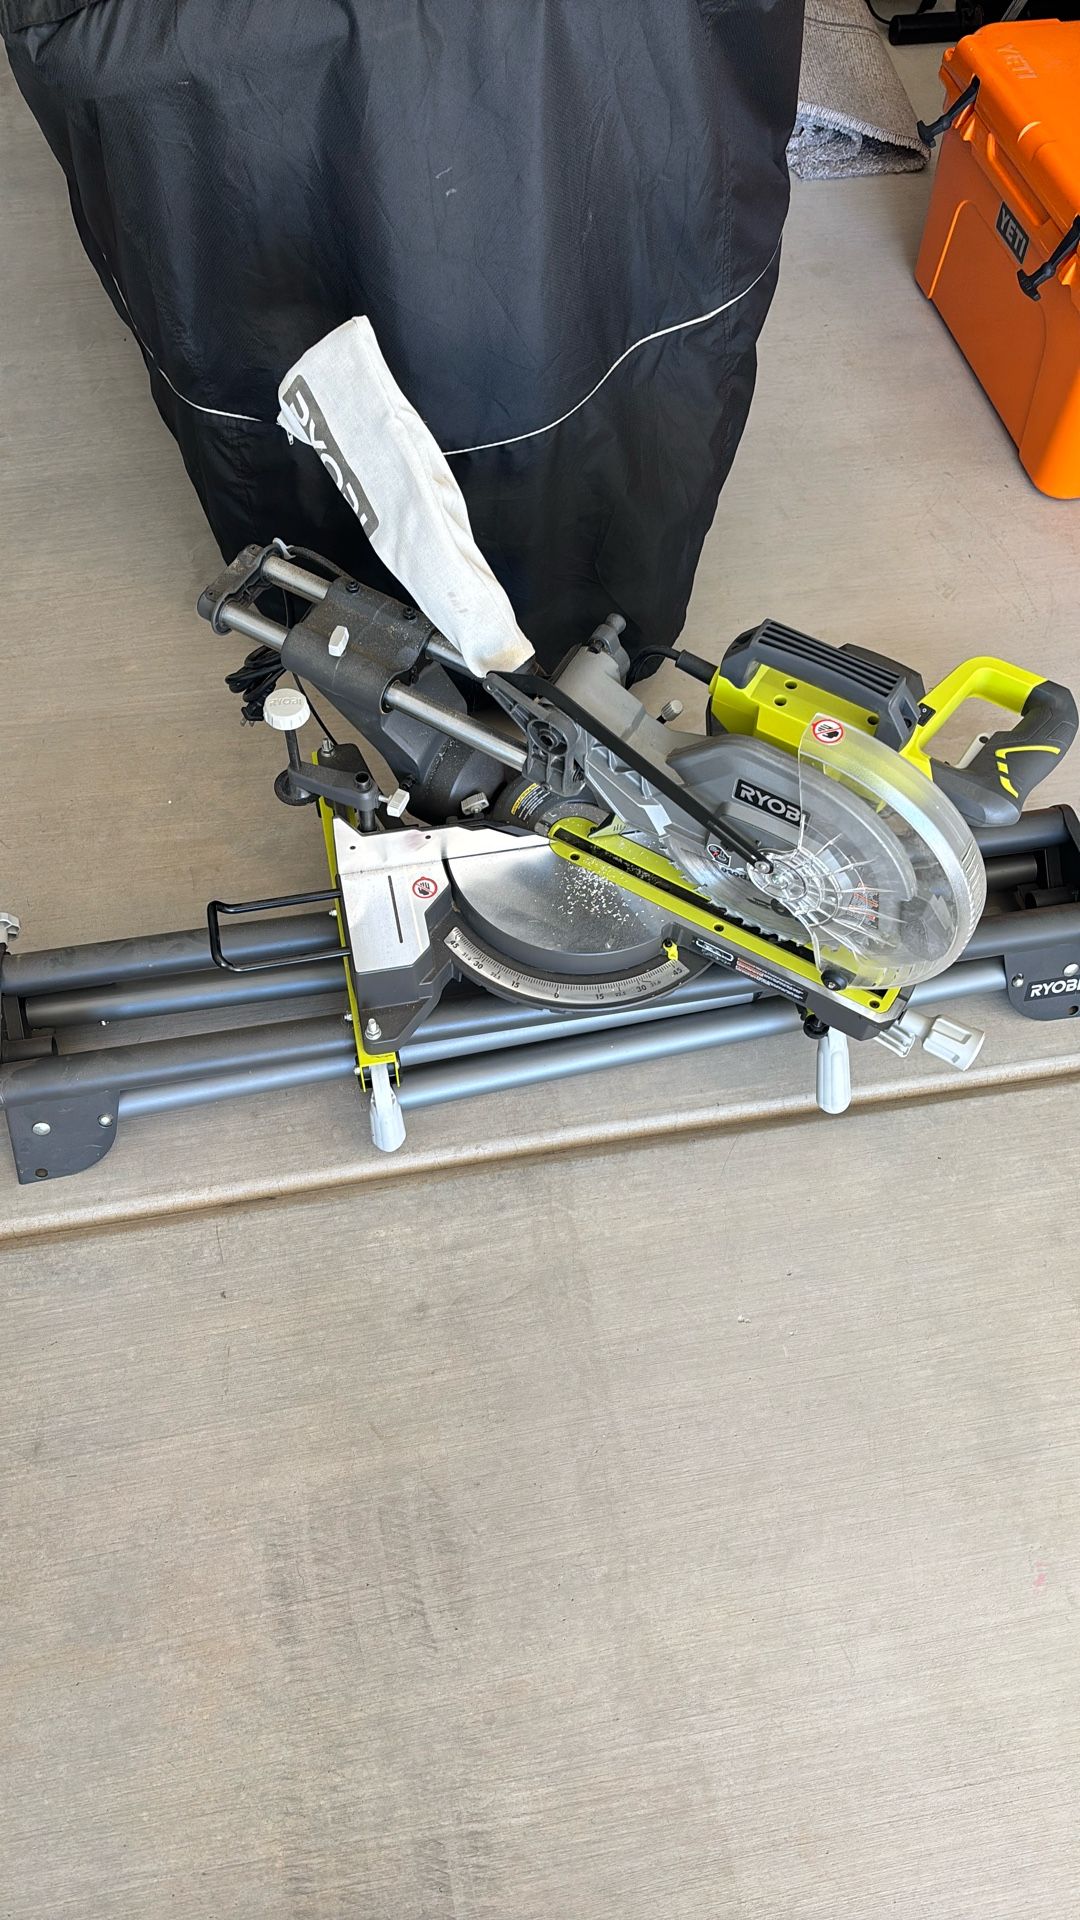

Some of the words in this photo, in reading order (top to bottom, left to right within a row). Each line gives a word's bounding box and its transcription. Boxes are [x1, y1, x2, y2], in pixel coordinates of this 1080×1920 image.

[997, 43, 1039, 79] YETI
[1001, 208, 1026, 257] YETI
[450, 940, 460, 949] 45
[473, 961, 484, 969] 30
[511, 980, 520, 988] 15
[636, 984, 647, 993] 30
[672, 967, 683, 977] 45
